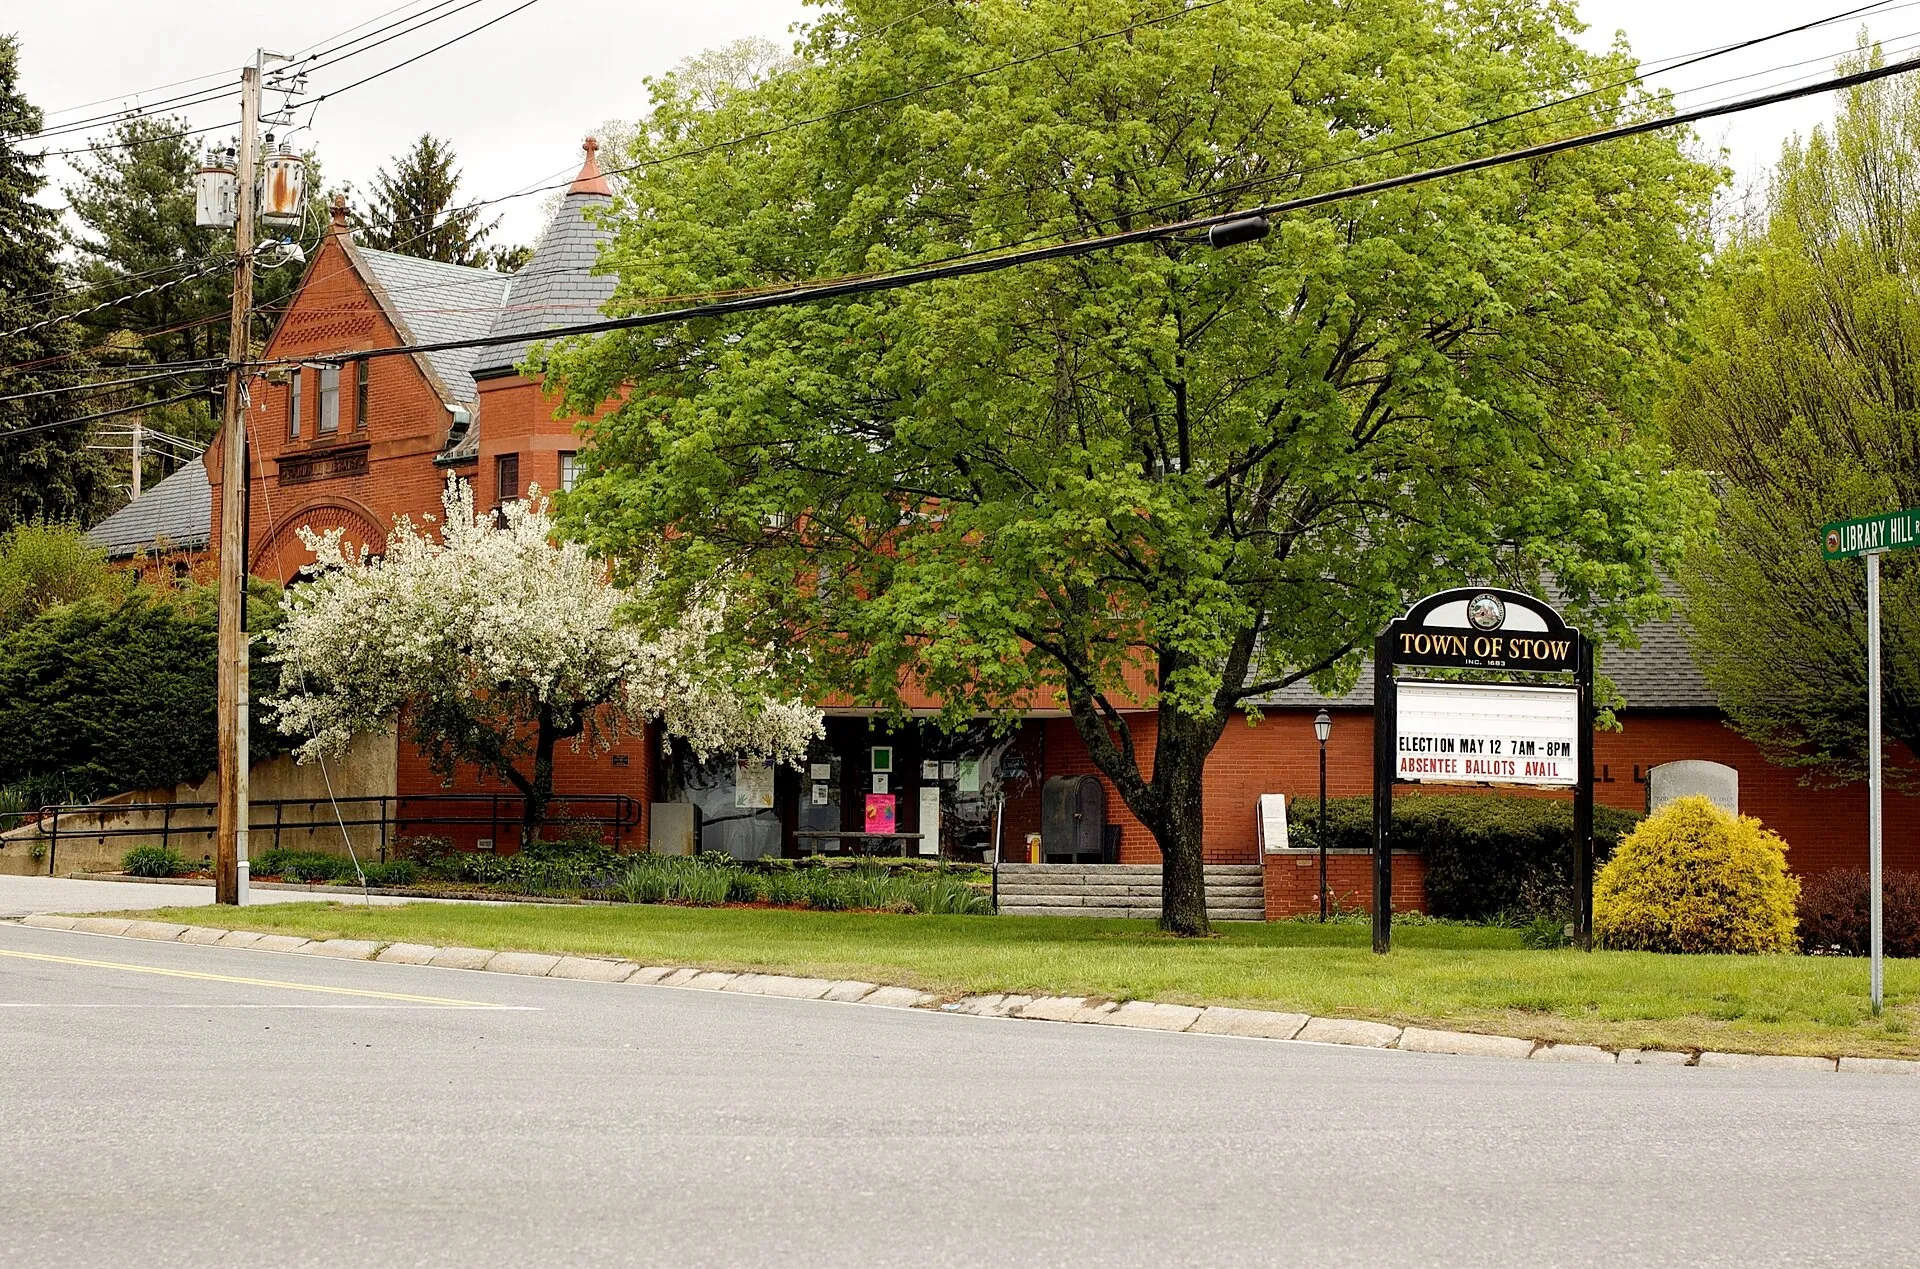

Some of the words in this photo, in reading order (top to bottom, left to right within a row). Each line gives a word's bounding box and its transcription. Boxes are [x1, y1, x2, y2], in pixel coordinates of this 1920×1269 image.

[1840, 520, 1885, 552] LIBRARY
[1890, 516, 1913, 544] HILL
[1400, 633, 1468, 656] TOWN
[1474, 636, 1503, 657] OF
[1508, 638, 1571, 660] STOW
[1399, 736, 1455, 753] ELECTION
[1460, 739, 1485, 754] MAY
[1489, 740, 1501, 754] 12
[1400, 757, 1457, 773] ABSENTEE
[1465, 759, 1515, 775] BALLOTS
[1525, 762, 1558, 777] AVAIL
